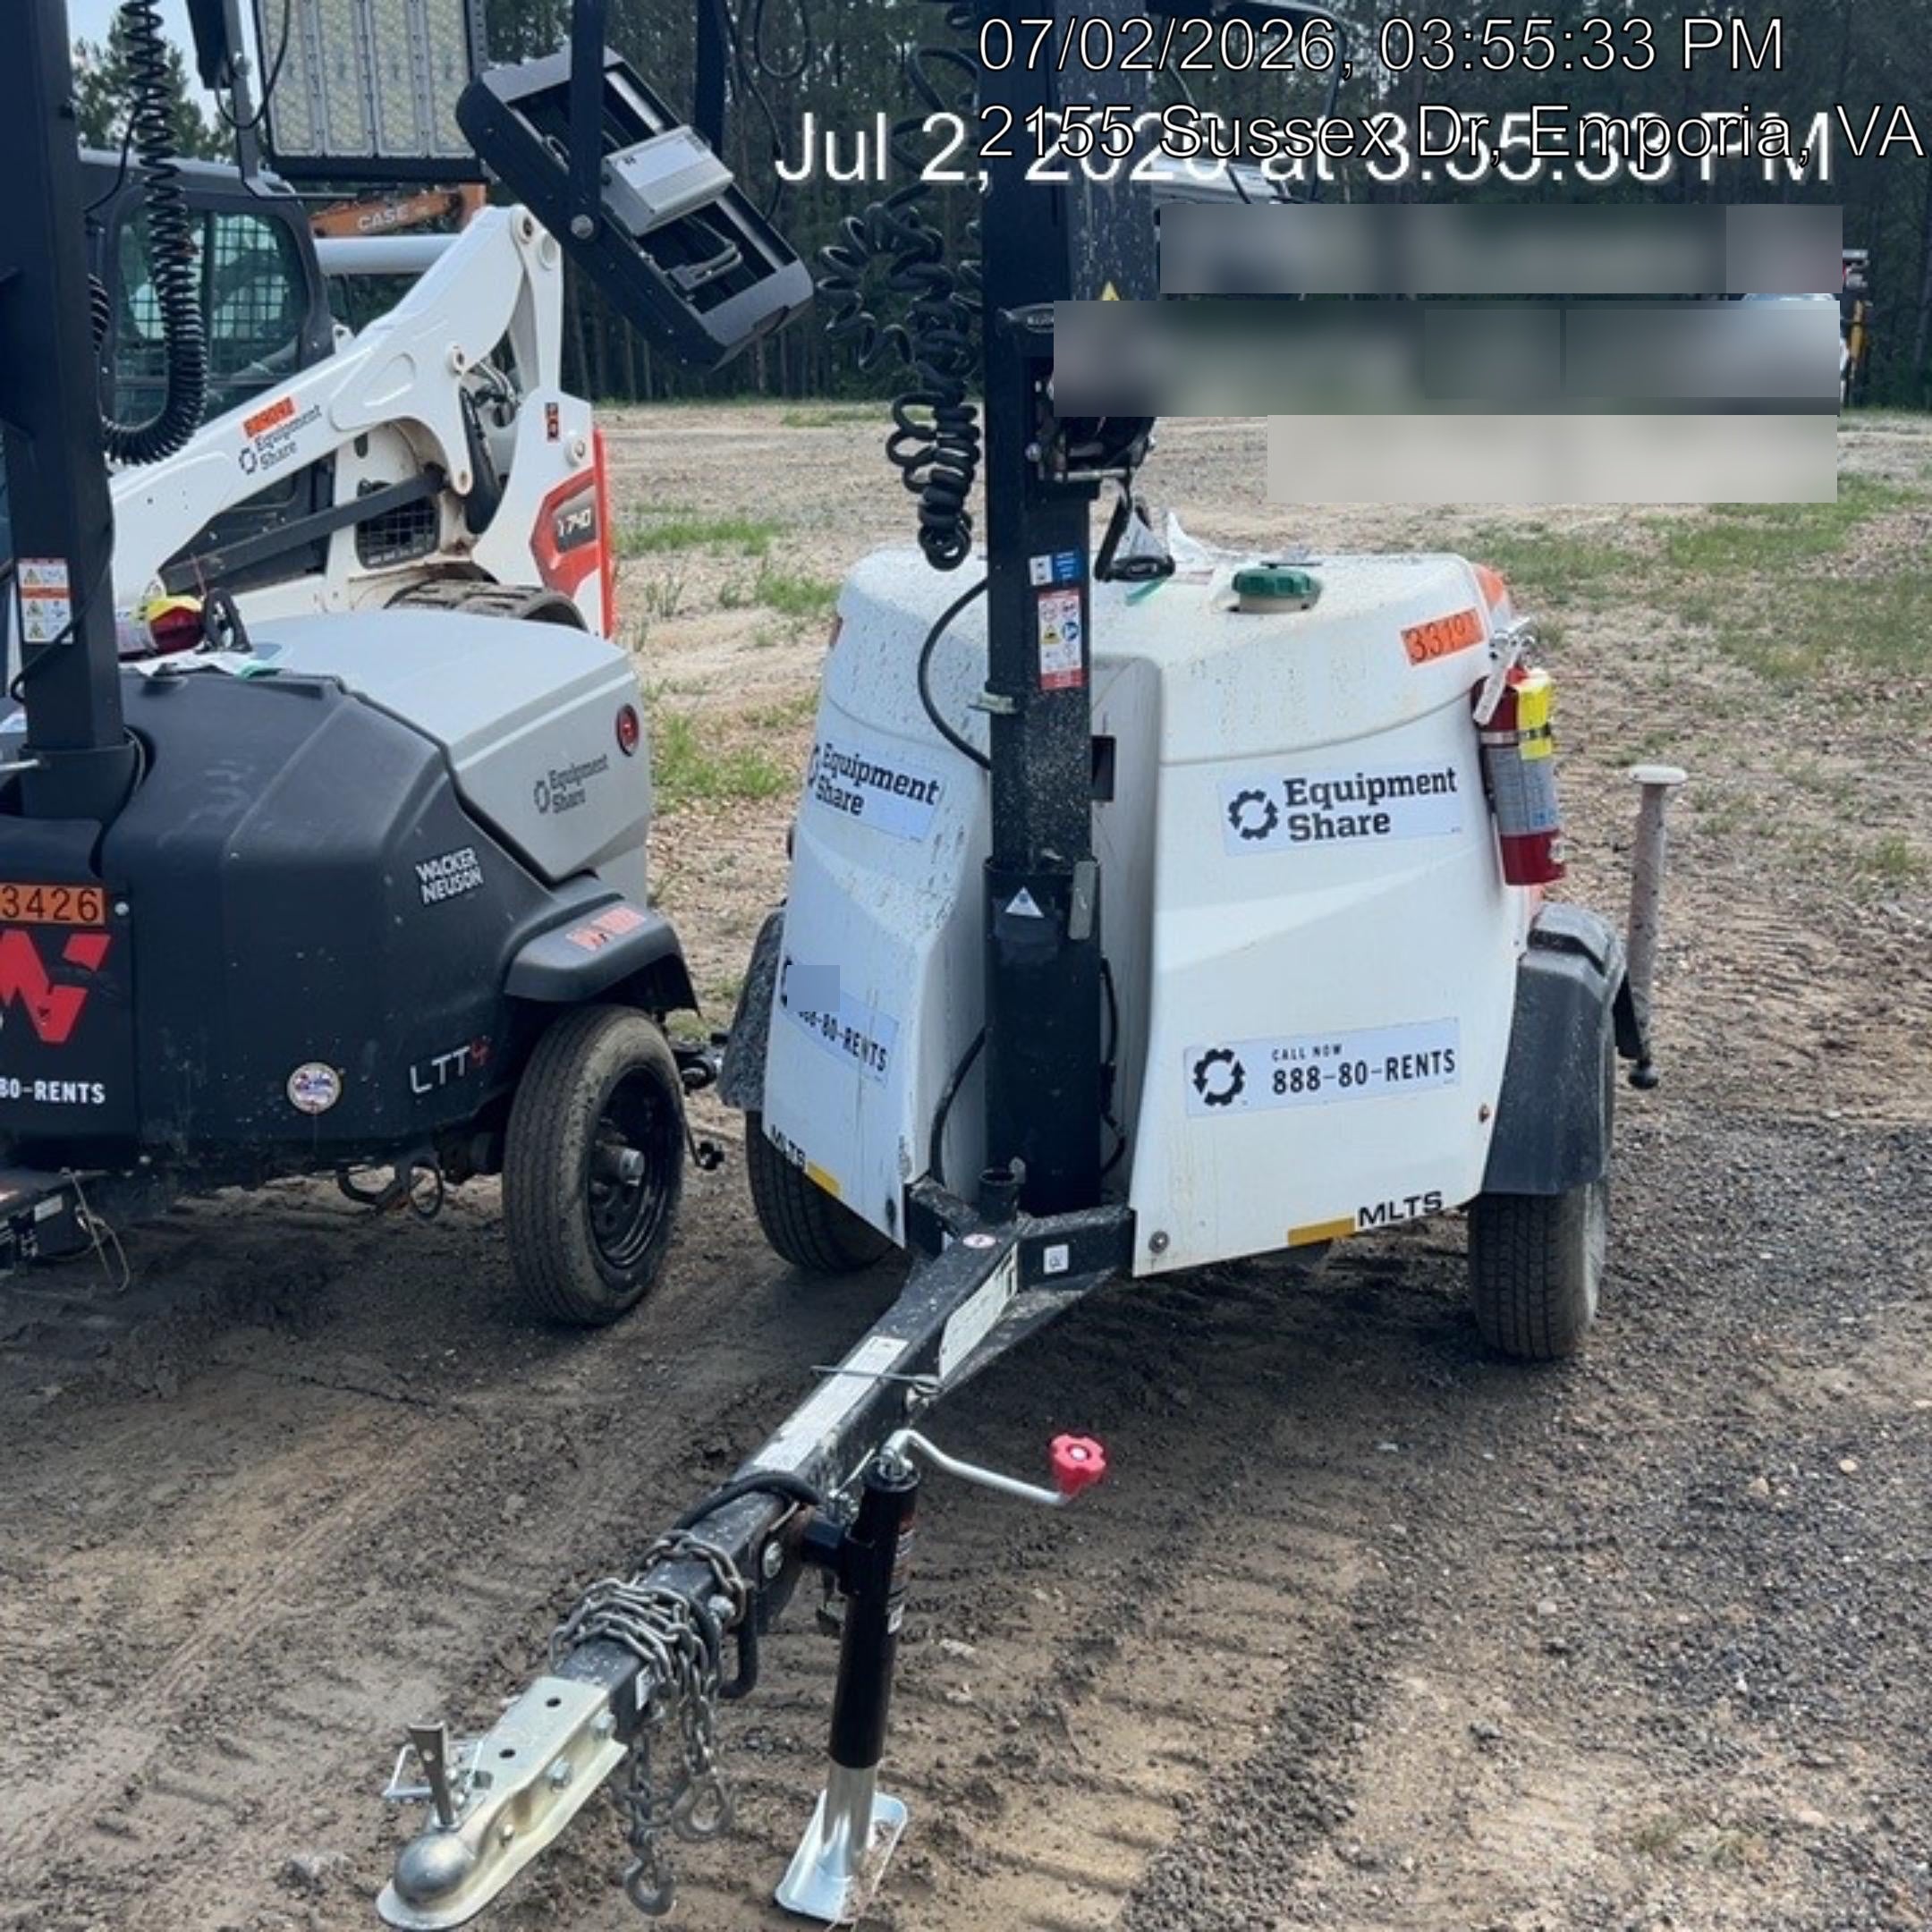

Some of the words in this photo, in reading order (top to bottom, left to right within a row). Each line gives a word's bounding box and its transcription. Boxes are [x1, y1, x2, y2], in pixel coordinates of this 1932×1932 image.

[359, 204, 410, 231] CASE
[547, 753, 609, 792] Equipment
[823, 741, 941, 806] Equipment
[1283, 767, 1457, 810] Equipment
[552, 788, 586, 814] Share
[816, 775, 865, 816] Share
[1287, 811, 1391, 841] Share
[415, 847, 479, 884] WACKER
[2, 885, 98, 922] 3426
[421, 866, 484, 904] NEUSON
[1272, 1047, 1306, 1063] CALL
[1312, 1044, 1342, 1058] NOW
[1273, 1048, 1455, 1095] 888-80-RENTS
[1358, 1191, 1442, 1227] MLTS
